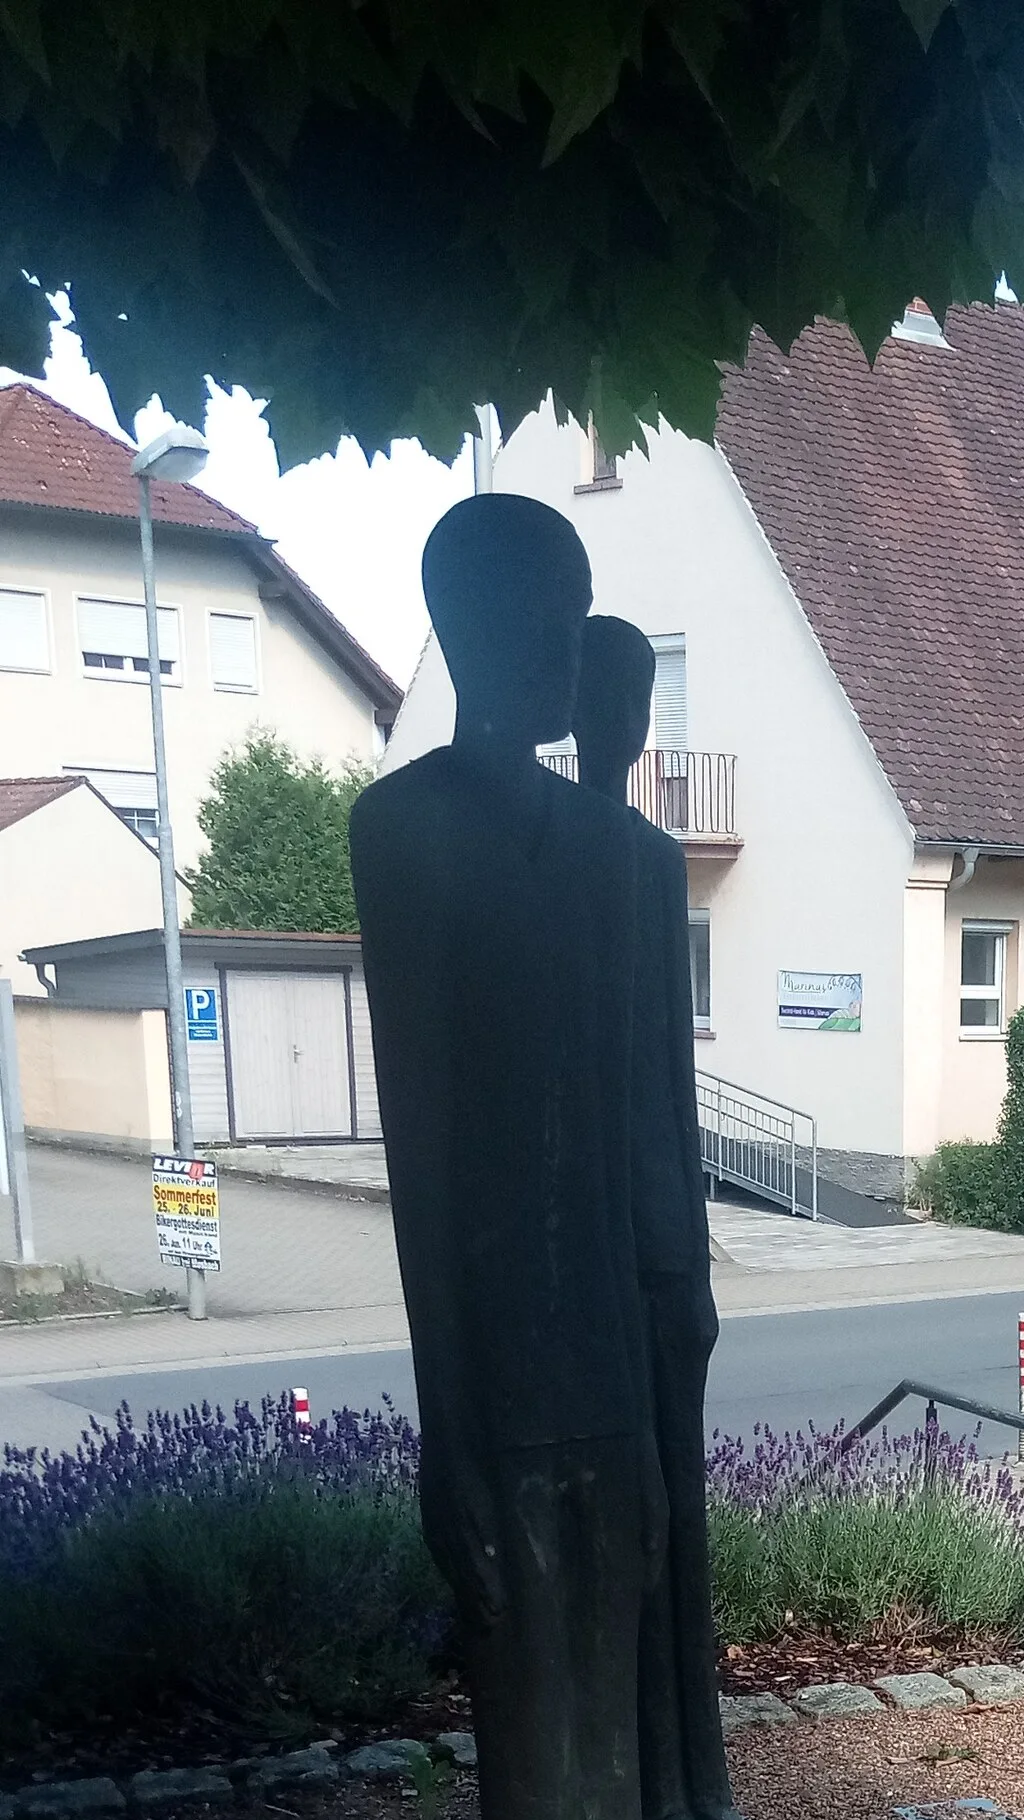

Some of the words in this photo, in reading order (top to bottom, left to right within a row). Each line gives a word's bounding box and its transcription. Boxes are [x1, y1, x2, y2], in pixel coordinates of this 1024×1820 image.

[191, 989, 210, 1020] P
[153, 1173, 215, 1187] Direktverkauf
[153, 1185, 216, 1206] Sommerfest
[157, 1201, 170, 1213] 25.
[178, 1203, 192, 1215] 26.
[194, 1205, 215, 1217] Juni
[156, 1214, 218, 1232] Bikergottesdienst
[182, 1237, 190, 1249] 11
